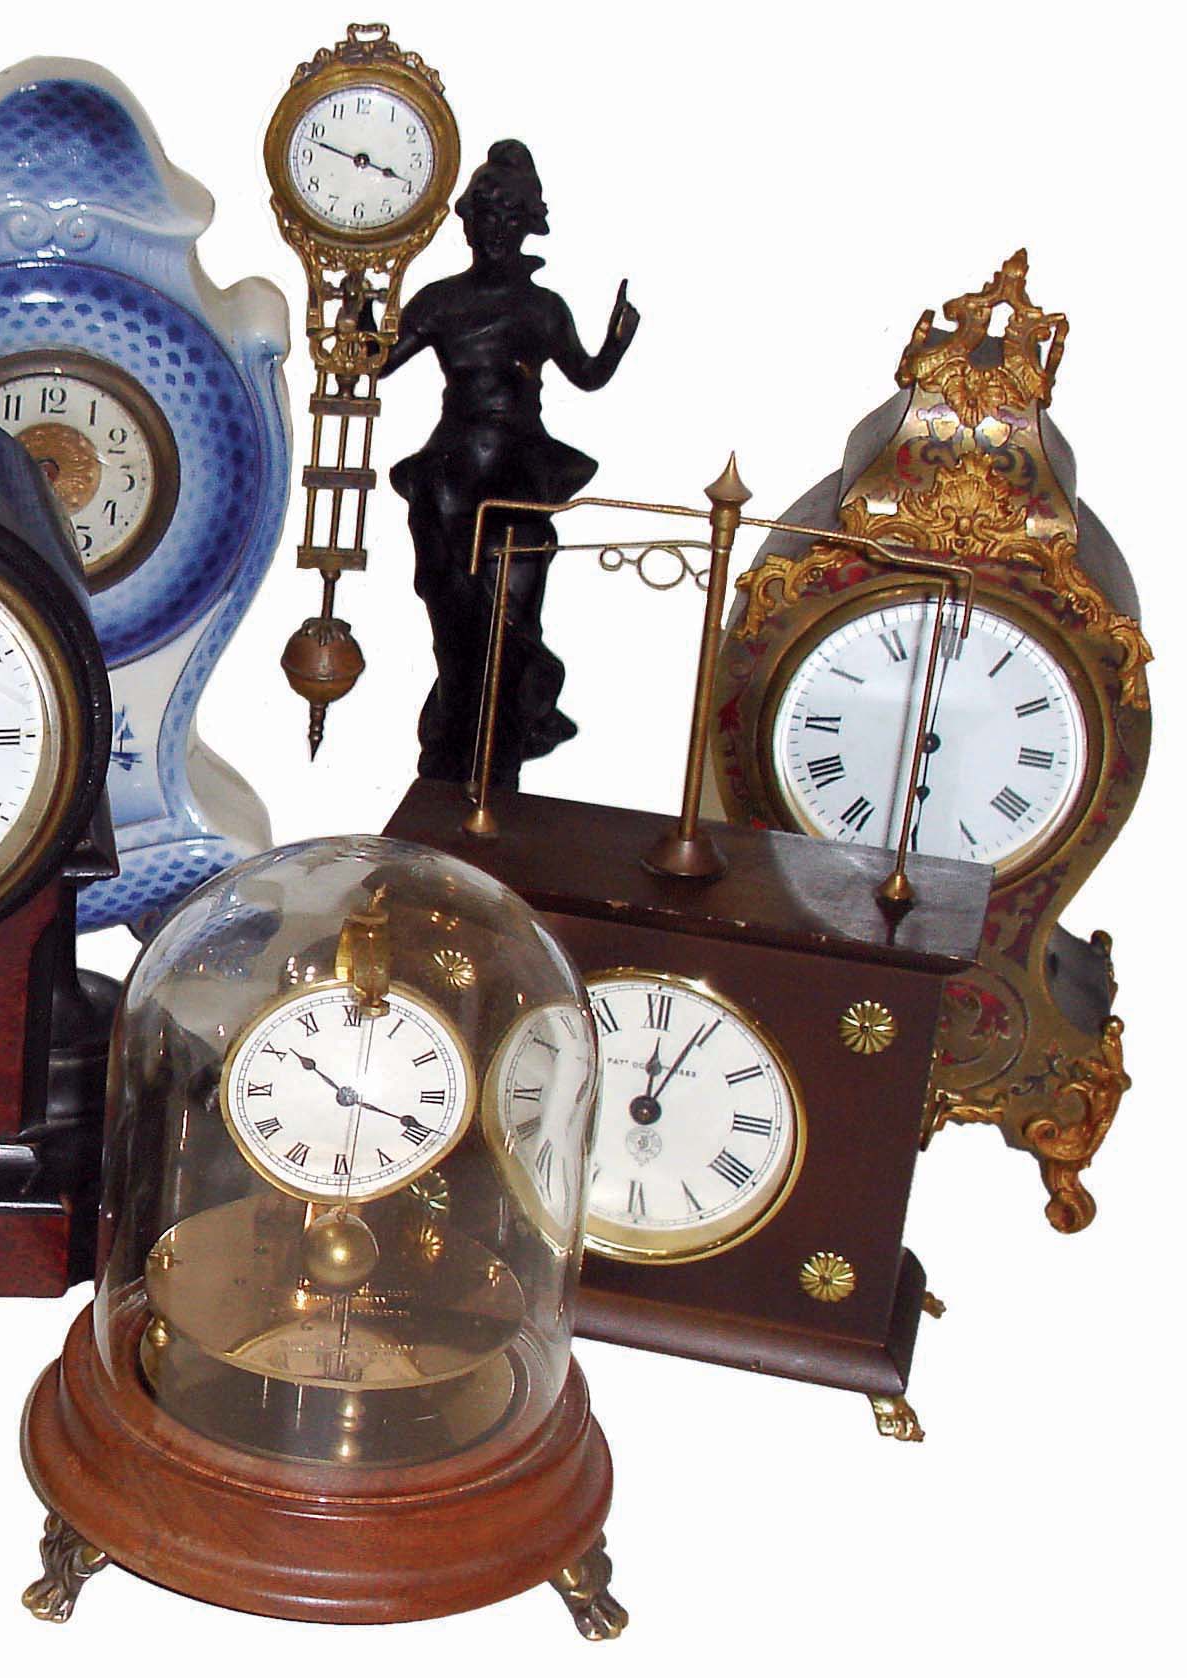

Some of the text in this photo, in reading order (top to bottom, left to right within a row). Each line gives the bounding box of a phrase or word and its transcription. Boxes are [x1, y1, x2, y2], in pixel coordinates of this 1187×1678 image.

[333, 104, 344, 120] 11
[356, 97, 371, 114] 12
[391, 106, 395, 122] 1
[311, 122, 325, 137] 10
[406, 126, 416, 144] 2
[302, 150, 313, 166] 9
[410, 153, 421, 169] 3
[308, 176, 319, 192] 8
[402, 181, 412, 195] 4
[328, 195, 339, 212] 7
[353, 203, 364, 219] 6
[380, 199, 391, 214] 5
[4, 394, 21, 421] 11
[41, 387, 66, 414] 12
[89, 400, 96, 426] 1
[108, 428, 127, 454] 2
[120, 465, 135, 492] 3
[77, 525, 93, 551] 5
[989, 651, 1013, 678] I
[1015, 697, 1050, 718] II
[805, 716, 841, 733] IX
[1018, 747, 1054, 769] III
[807, 754, 845, 788] VIII
[840, 796, 875, 832] VII
[990, 786, 1031, 822] IIII
[343, 1005, 361, 1028] XII
[642, 993, 672, 1032] XII
[297, 1012, 319, 1036] XI
[388, 1018, 404, 1039] I
[697, 1019, 720, 1046] I
[262, 1042, 286, 1061] X
[412, 1049, 437, 1067] II
[725, 1065, 764, 1085] II
[248, 1081, 272, 1097] IX
[421, 1089, 445, 1105] III
[255, 1117, 283, 1139] VIII
[732, 1111, 773, 1137] III
[285, 1142, 310, 1167] VII
[334, 1154, 349, 1176] VI
[377, 1148, 394, 1167] V
[708, 1148, 755, 1189] IIII
[627, 1180, 645, 1216] VI
[681, 1179, 702, 1213] V
